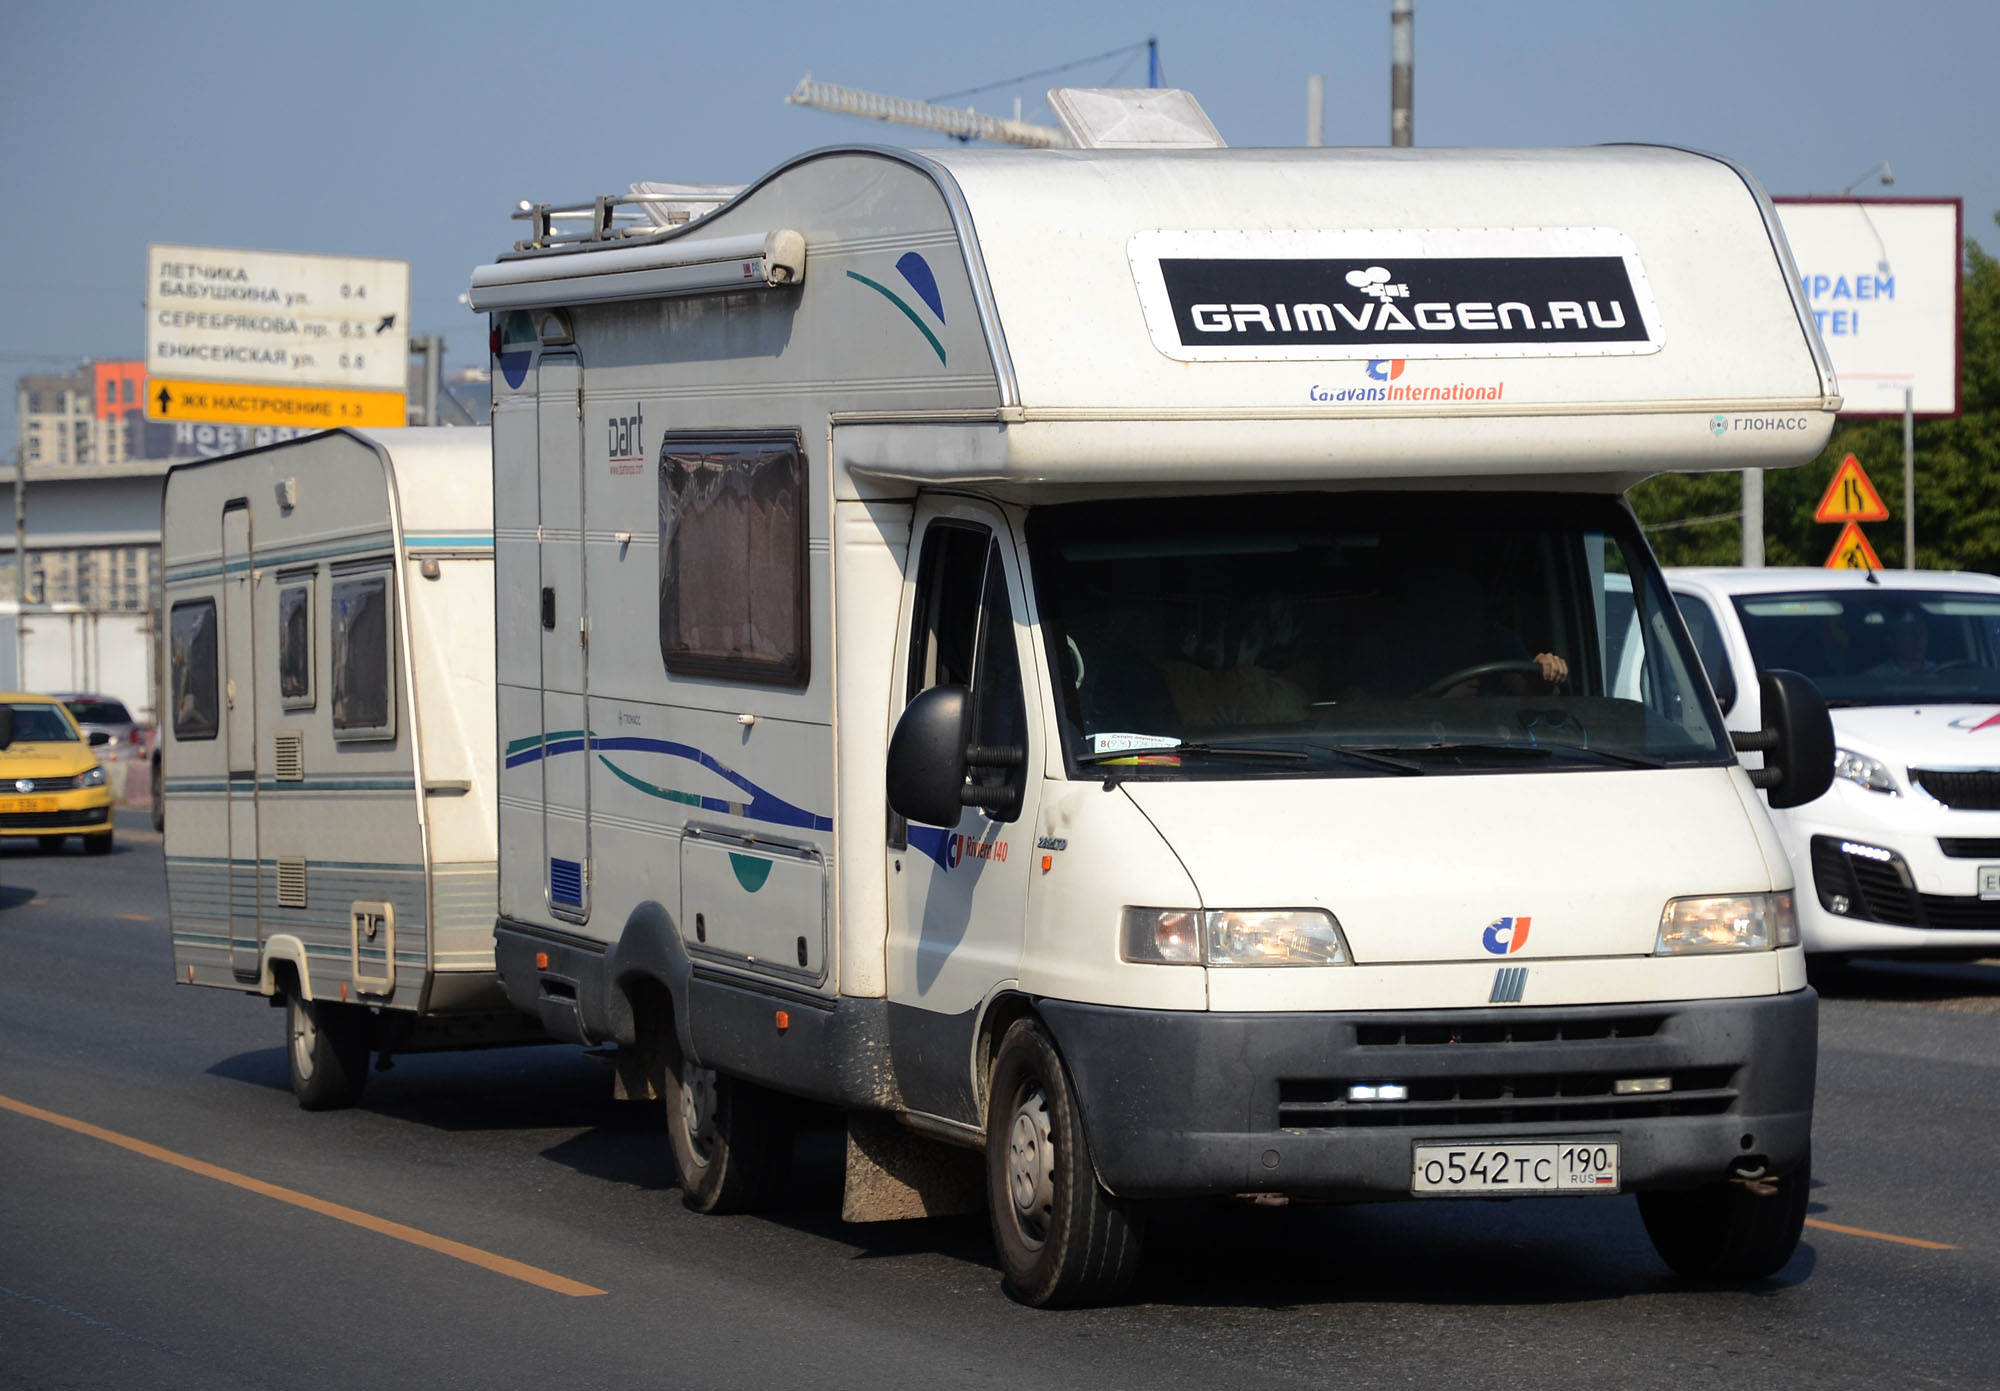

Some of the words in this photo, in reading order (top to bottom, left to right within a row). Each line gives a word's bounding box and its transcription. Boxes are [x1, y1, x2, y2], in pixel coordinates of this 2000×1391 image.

[160, 281, 280, 302] БАБУШКИНА
[159, 310, 299, 335] СЕРЕБРЯКОВА
[157, 341, 287, 364] ЕНИСЕЙСКАЯ
[212, 395, 332, 417] НАСТРОЕНИЕ
[1734, 417, 1808, 431] ГЛОНАСС
[993, 840, 1009, 863] 140
[1562, 1147, 1608, 1173] 190
[1571, 1174, 1595, 1184] RUS
